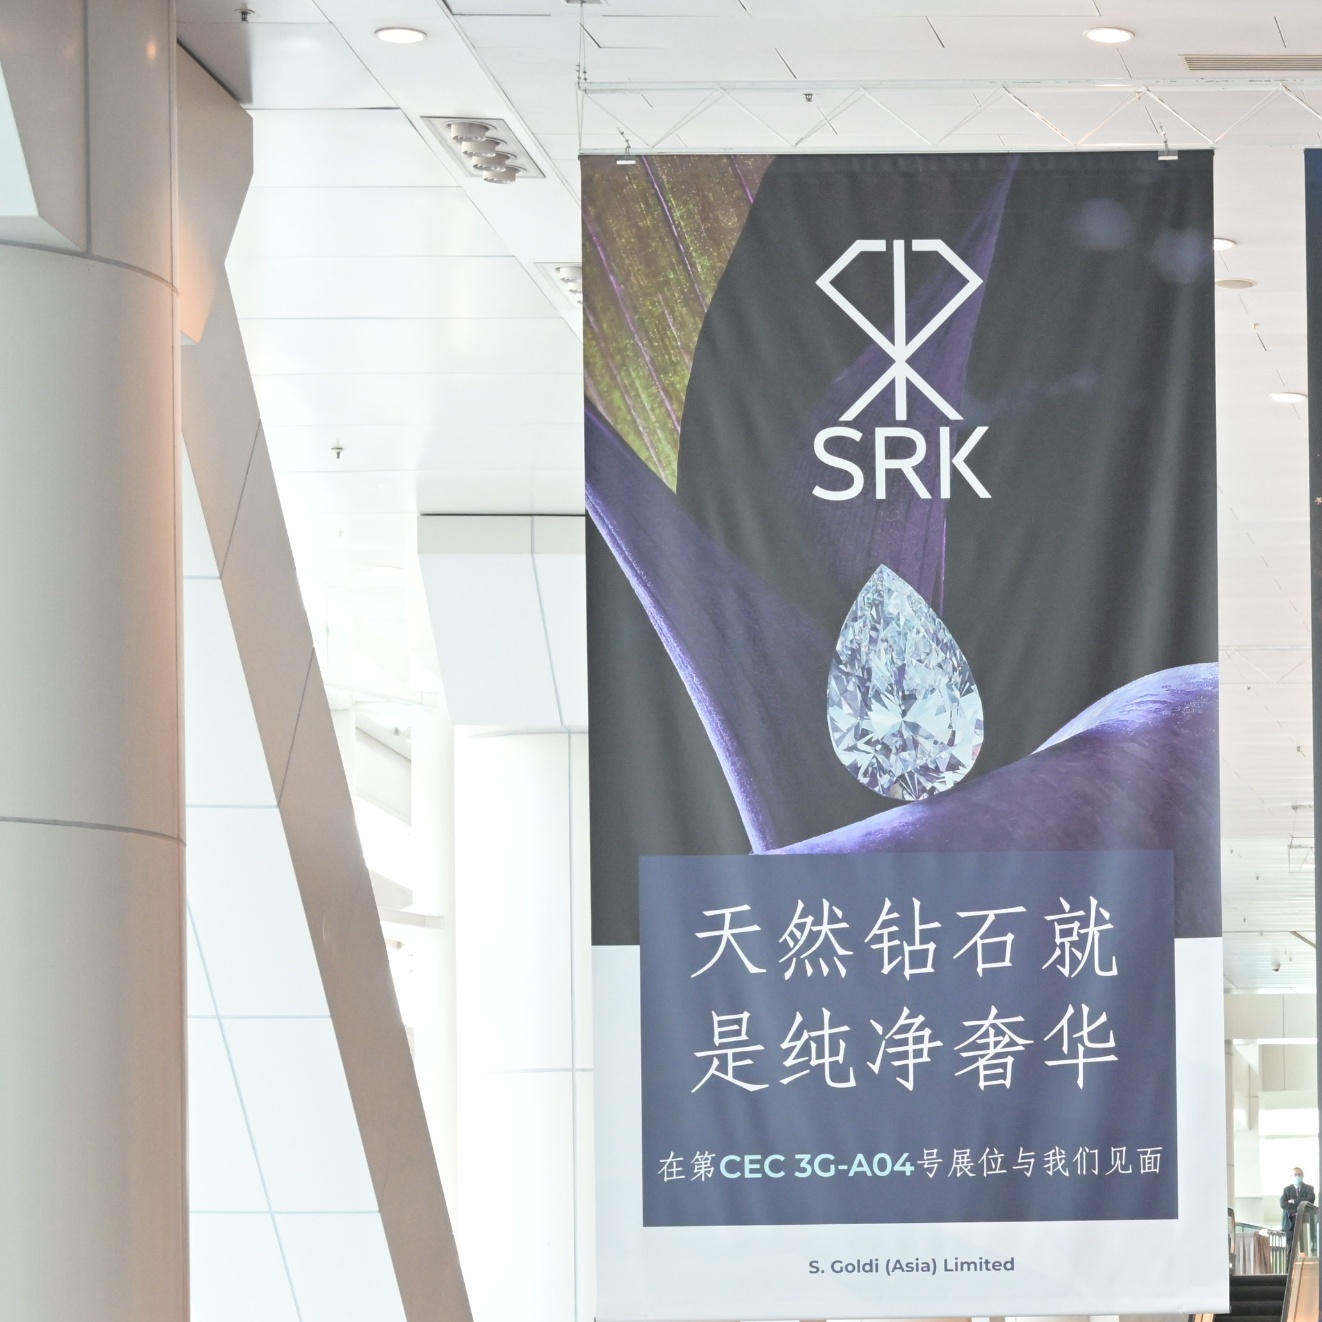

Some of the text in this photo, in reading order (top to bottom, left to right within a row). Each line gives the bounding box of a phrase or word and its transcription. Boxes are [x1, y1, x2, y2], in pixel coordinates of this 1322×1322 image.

[811, 426, 993, 502] SRK
[690, 895, 1119, 981] 天然钻石就
[690, 1003, 1119, 1094] 是纯净奢华
[657, 1145, 1163, 1183] 在第CEC 3G-A04号展位与我们见面
[808, 1256, 1015, 1277] S. Goldi (Asia) Limited
